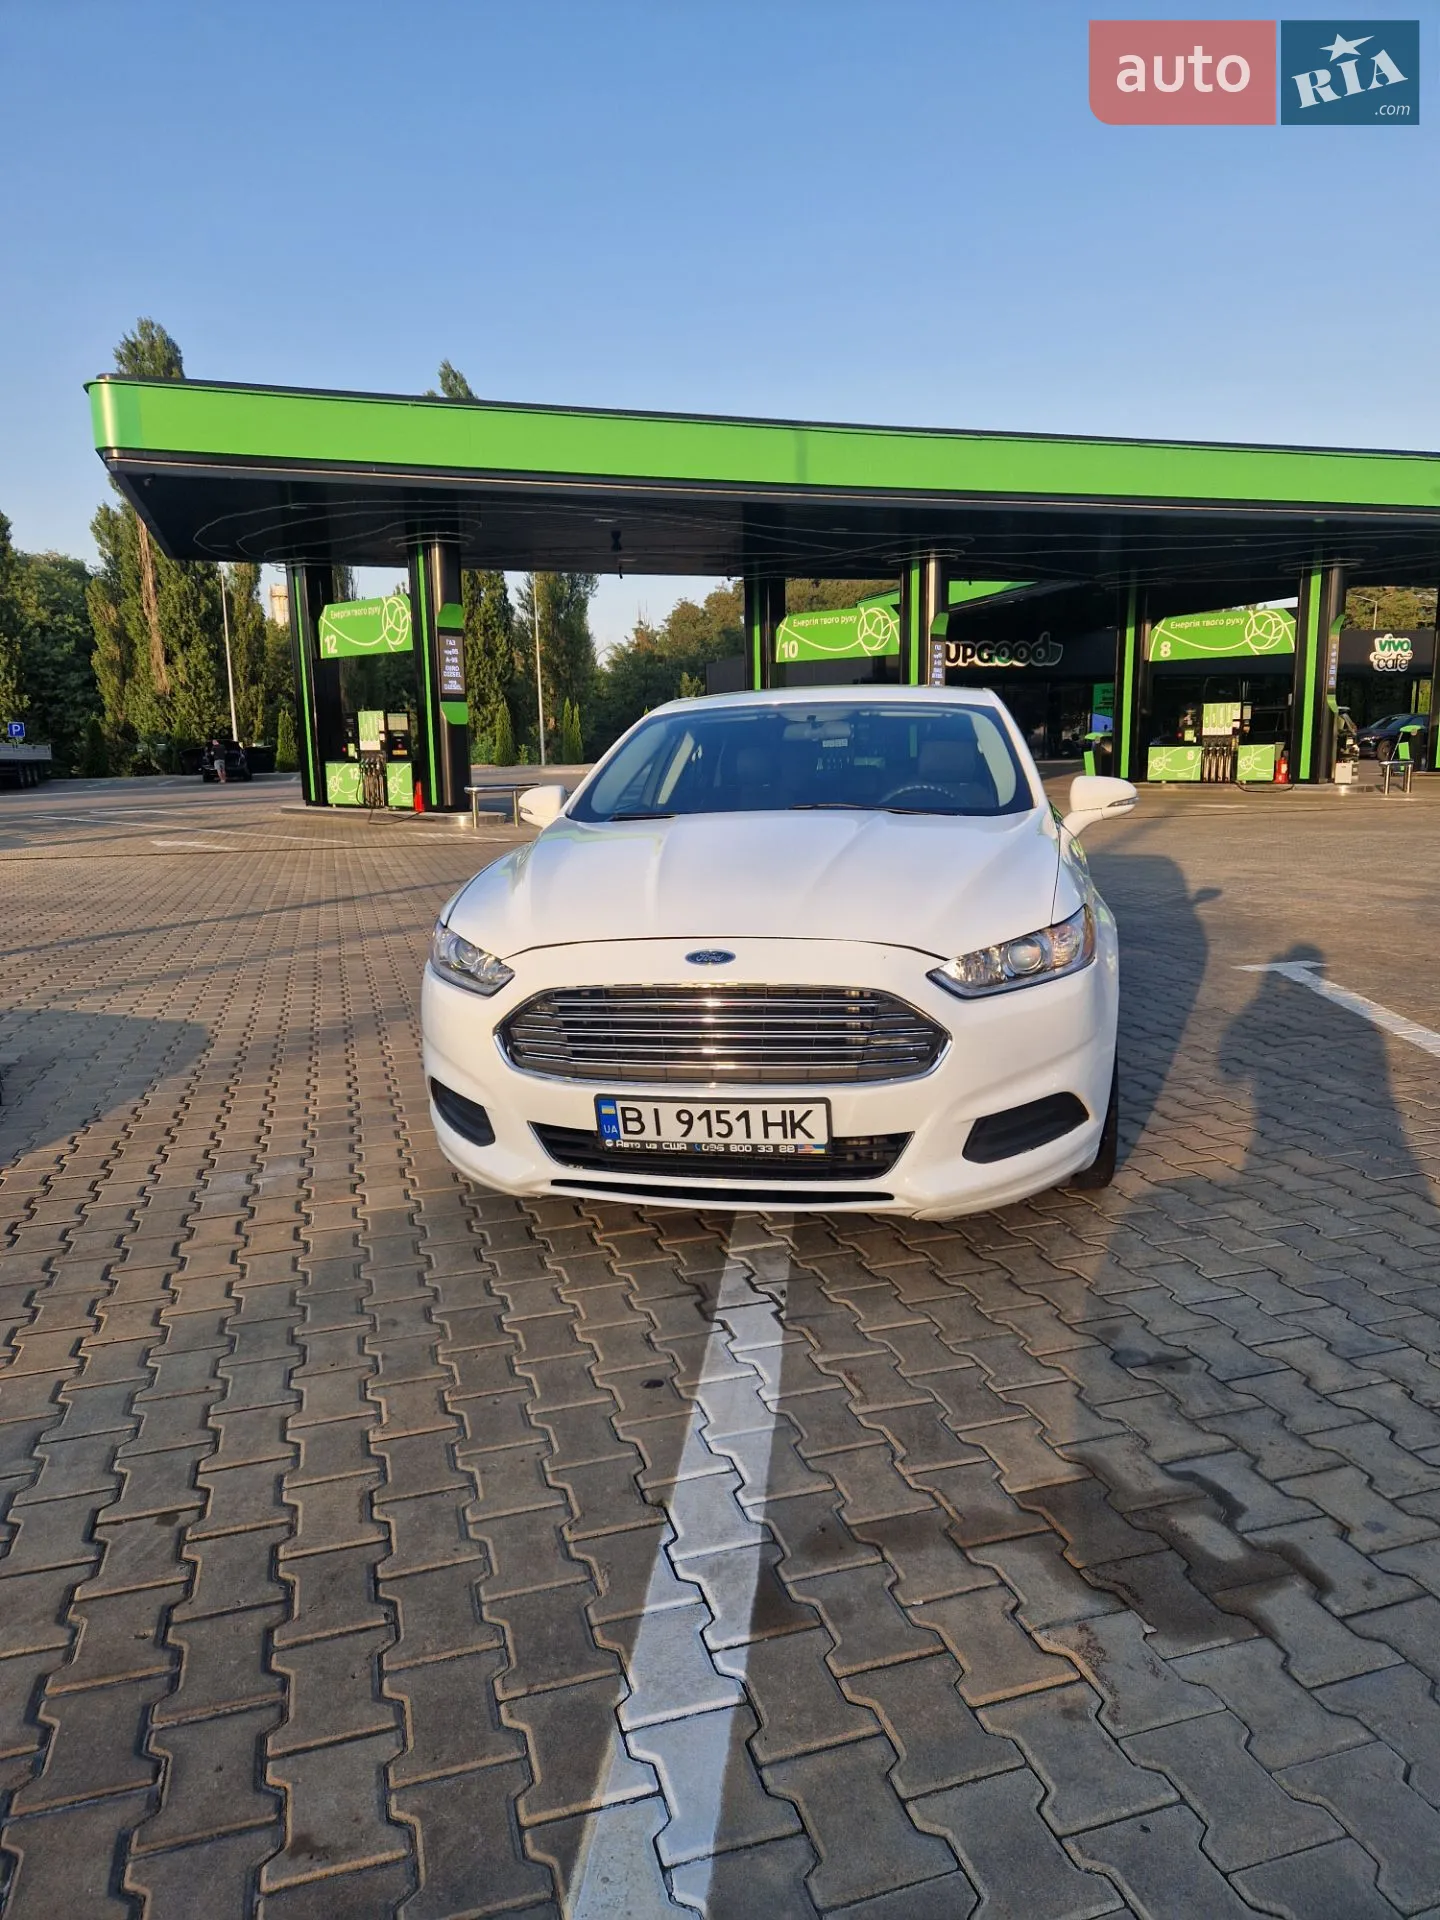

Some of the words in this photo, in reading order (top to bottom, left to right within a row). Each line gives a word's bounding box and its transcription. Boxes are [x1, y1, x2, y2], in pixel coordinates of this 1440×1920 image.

[793, 617, 818, 628] Енергія
[820, 616, 839, 625] твого
[841, 614, 857, 624] руху
[1170, 619, 1200, 630] Енергія
[1203, 618, 1224, 627] твого
[1226, 617, 1245, 626] руху
[324, 634, 338, 654] 12
[781, 640, 799, 658] 10
[1160, 641, 1171, 657] 8
[1378, 635, 1410, 652] vivo
[12, 724, 21, 736] P
[603, 1124, 618, 1134] UA
[620, 1106, 661, 1137] BI
[675, 1109, 751, 1140] 9151
[762, 1110, 815, 1140] HK
[616, 1140, 640, 1149] Авто
[662, 1142, 687, 1151] США
[729, 1144, 753, 1153] 800
[757, 1145, 774, 1153] 33
